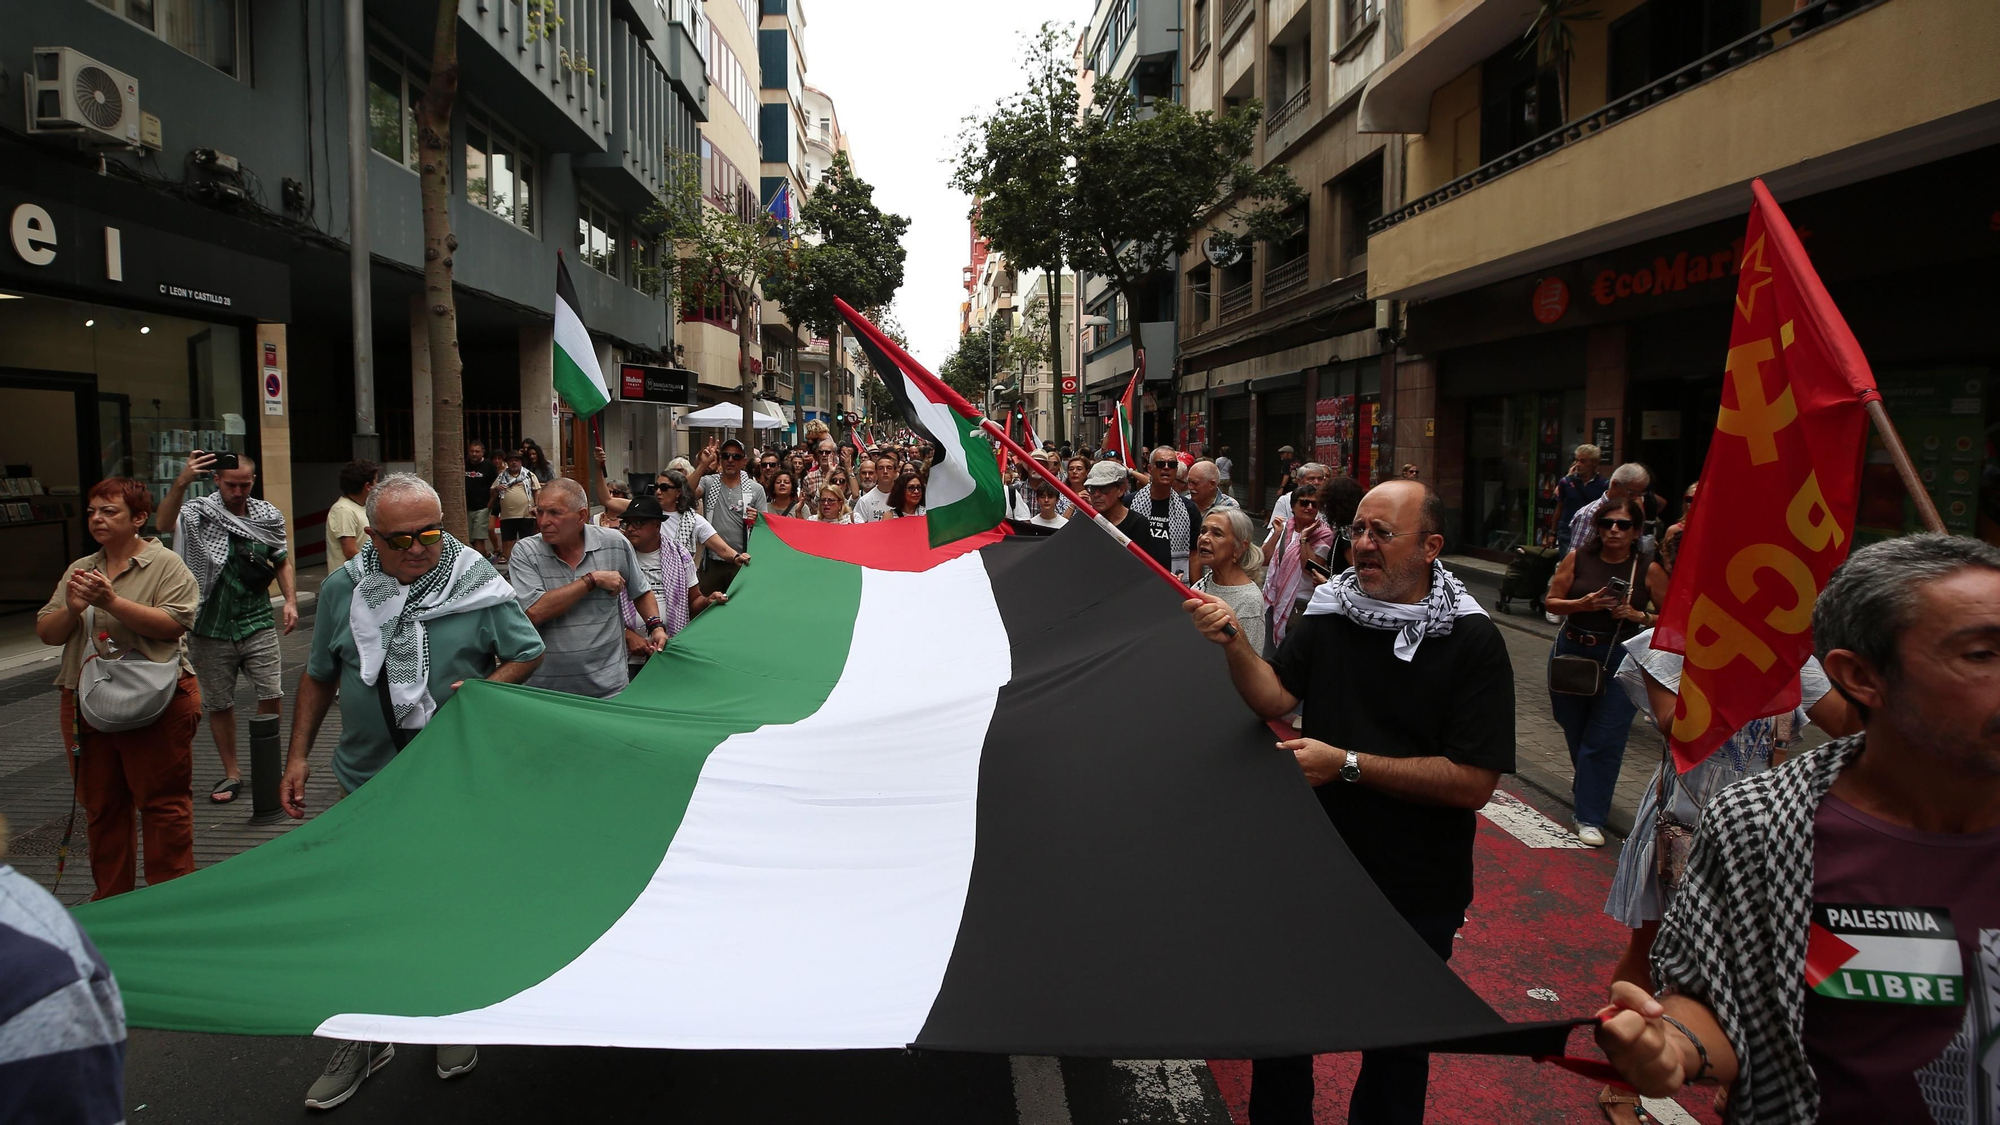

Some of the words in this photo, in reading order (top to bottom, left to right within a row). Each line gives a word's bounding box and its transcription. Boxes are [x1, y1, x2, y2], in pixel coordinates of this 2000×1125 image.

[169, 286, 187, 297] LEON
[188, 290, 193, 298] Y
[194, 291, 223, 304] CASTILLO
[1826, 908, 1940, 932] PALESTINA
[1842, 972, 1955, 1002] LIBRE
